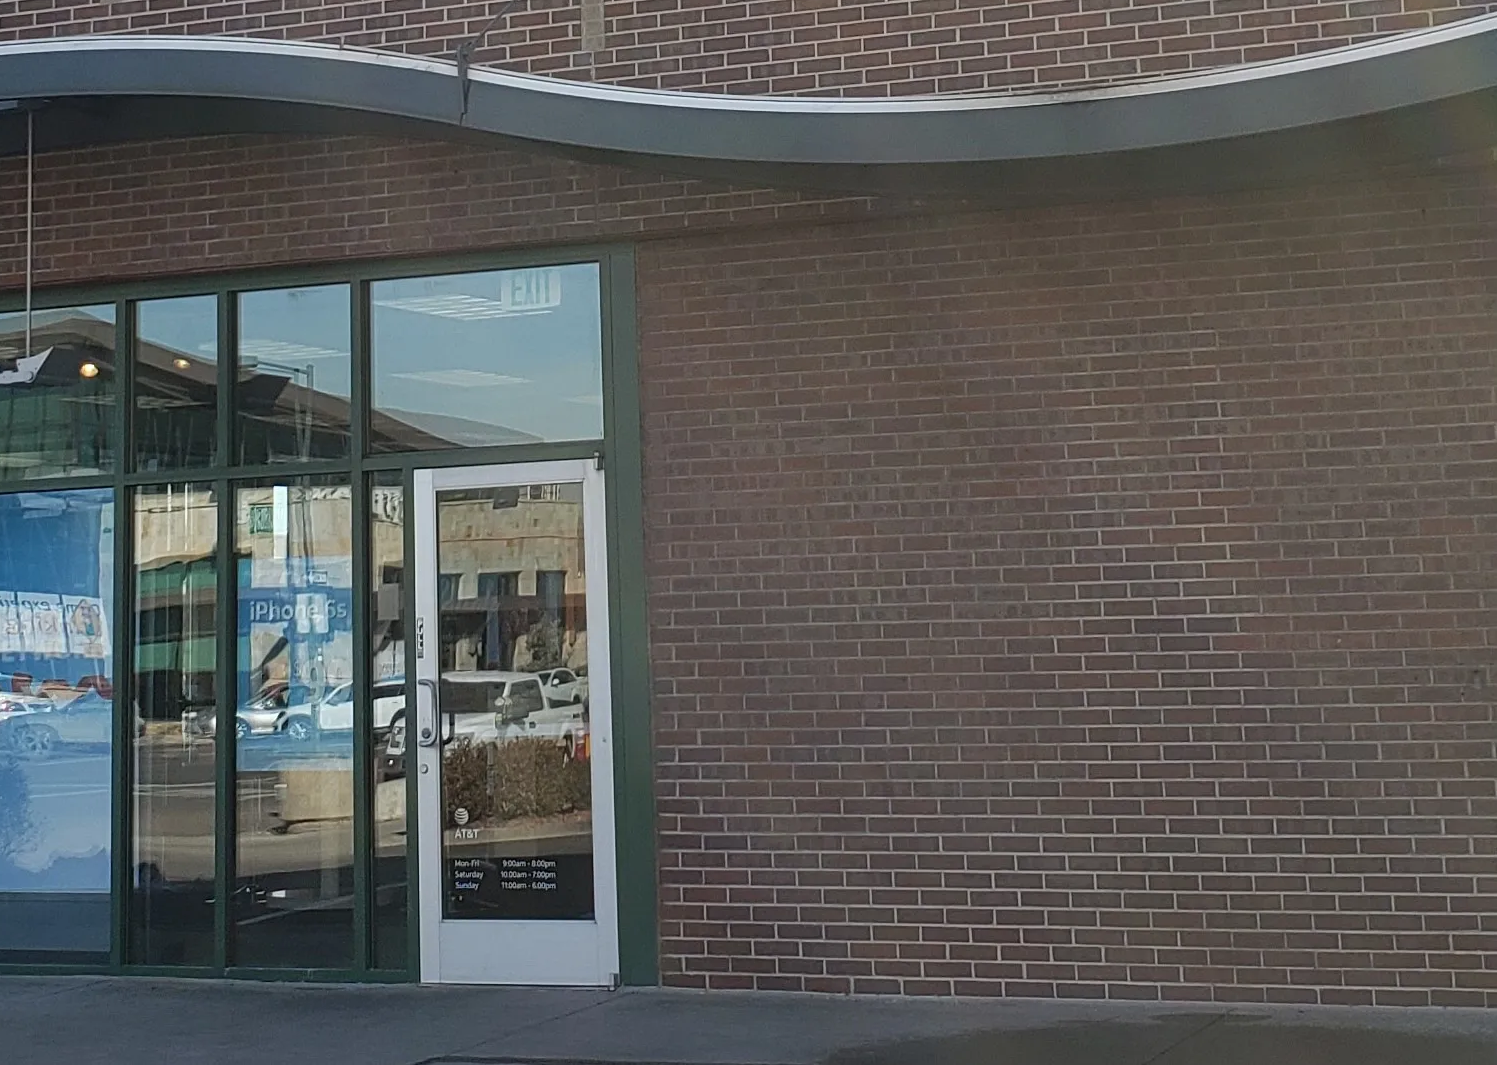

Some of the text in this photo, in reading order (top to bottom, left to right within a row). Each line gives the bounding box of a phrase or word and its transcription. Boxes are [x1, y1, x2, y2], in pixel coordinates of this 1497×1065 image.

[250, 599, 347, 621] iPhone 6s
[454, 828, 479, 839] AT&T
[454, 859, 480, 868] Mon-Fri
[454, 870, 484, 880] Saturday
[455, 881, 479, 890] Sunday
